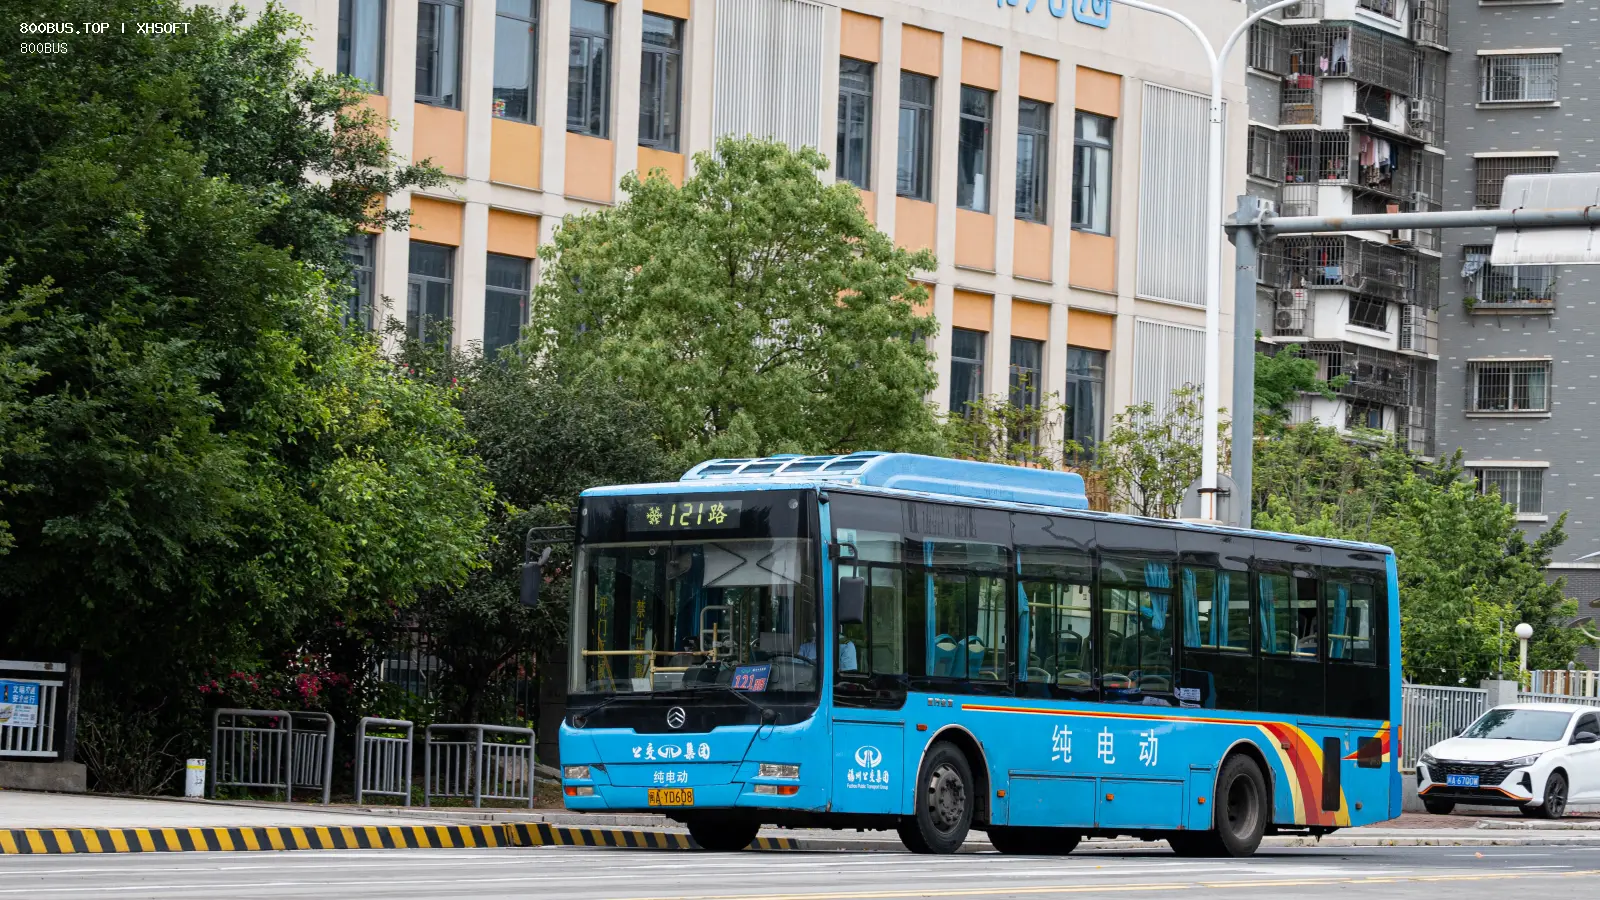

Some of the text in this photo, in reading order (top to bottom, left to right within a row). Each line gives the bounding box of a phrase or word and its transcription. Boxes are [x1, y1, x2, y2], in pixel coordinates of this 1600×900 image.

[669, 502, 728, 526] 121路
[1051, 724, 1159, 767] 纯电动
[653, 769, 689, 784] 纯电动
